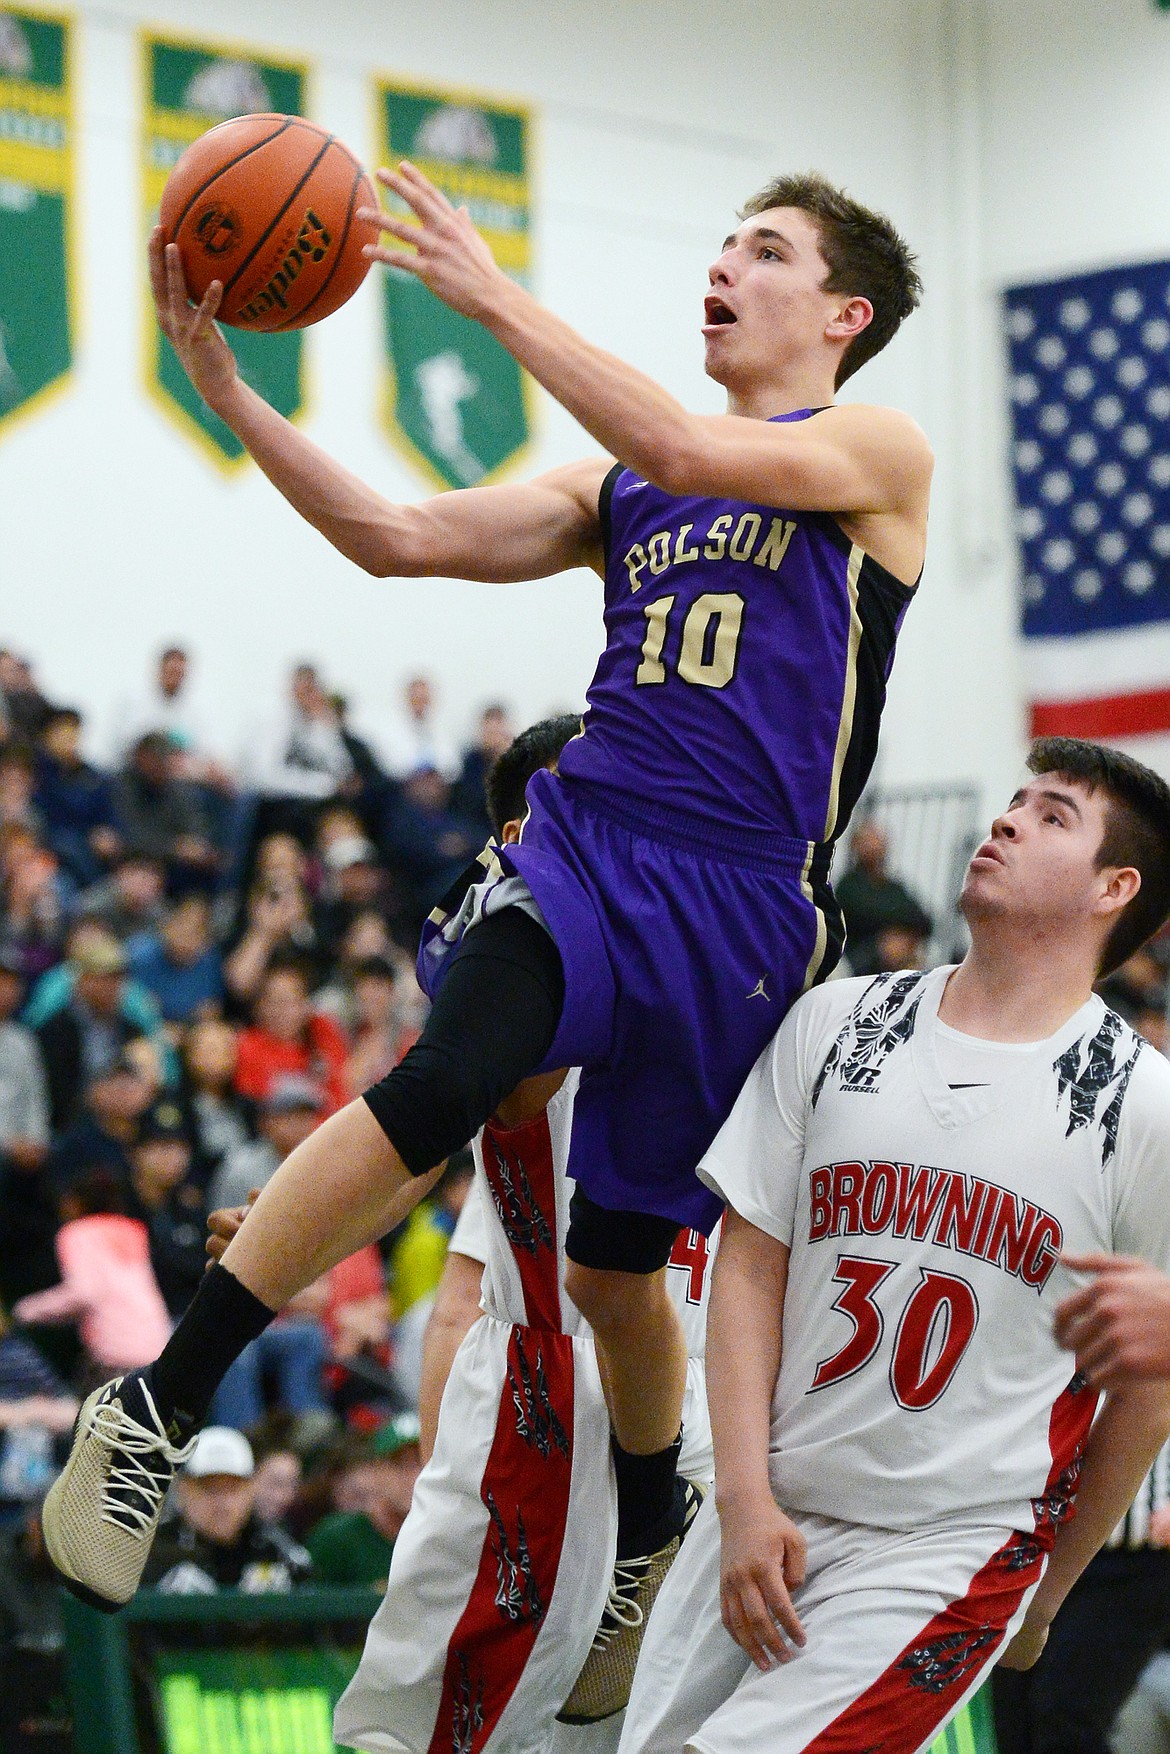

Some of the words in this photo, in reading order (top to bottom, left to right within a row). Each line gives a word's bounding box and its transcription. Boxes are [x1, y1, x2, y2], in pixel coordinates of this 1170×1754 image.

[236, 208, 332, 322] Baden
[622, 512, 798, 594] POLSON
[634, 592, 746, 690] 10
[838, 1084, 881, 1095] RUSSELL
[666, 1226, 711, 1306] 4
[808, 1159, 1065, 1297] BROWNING
[804, 1253, 981, 1413] 30
